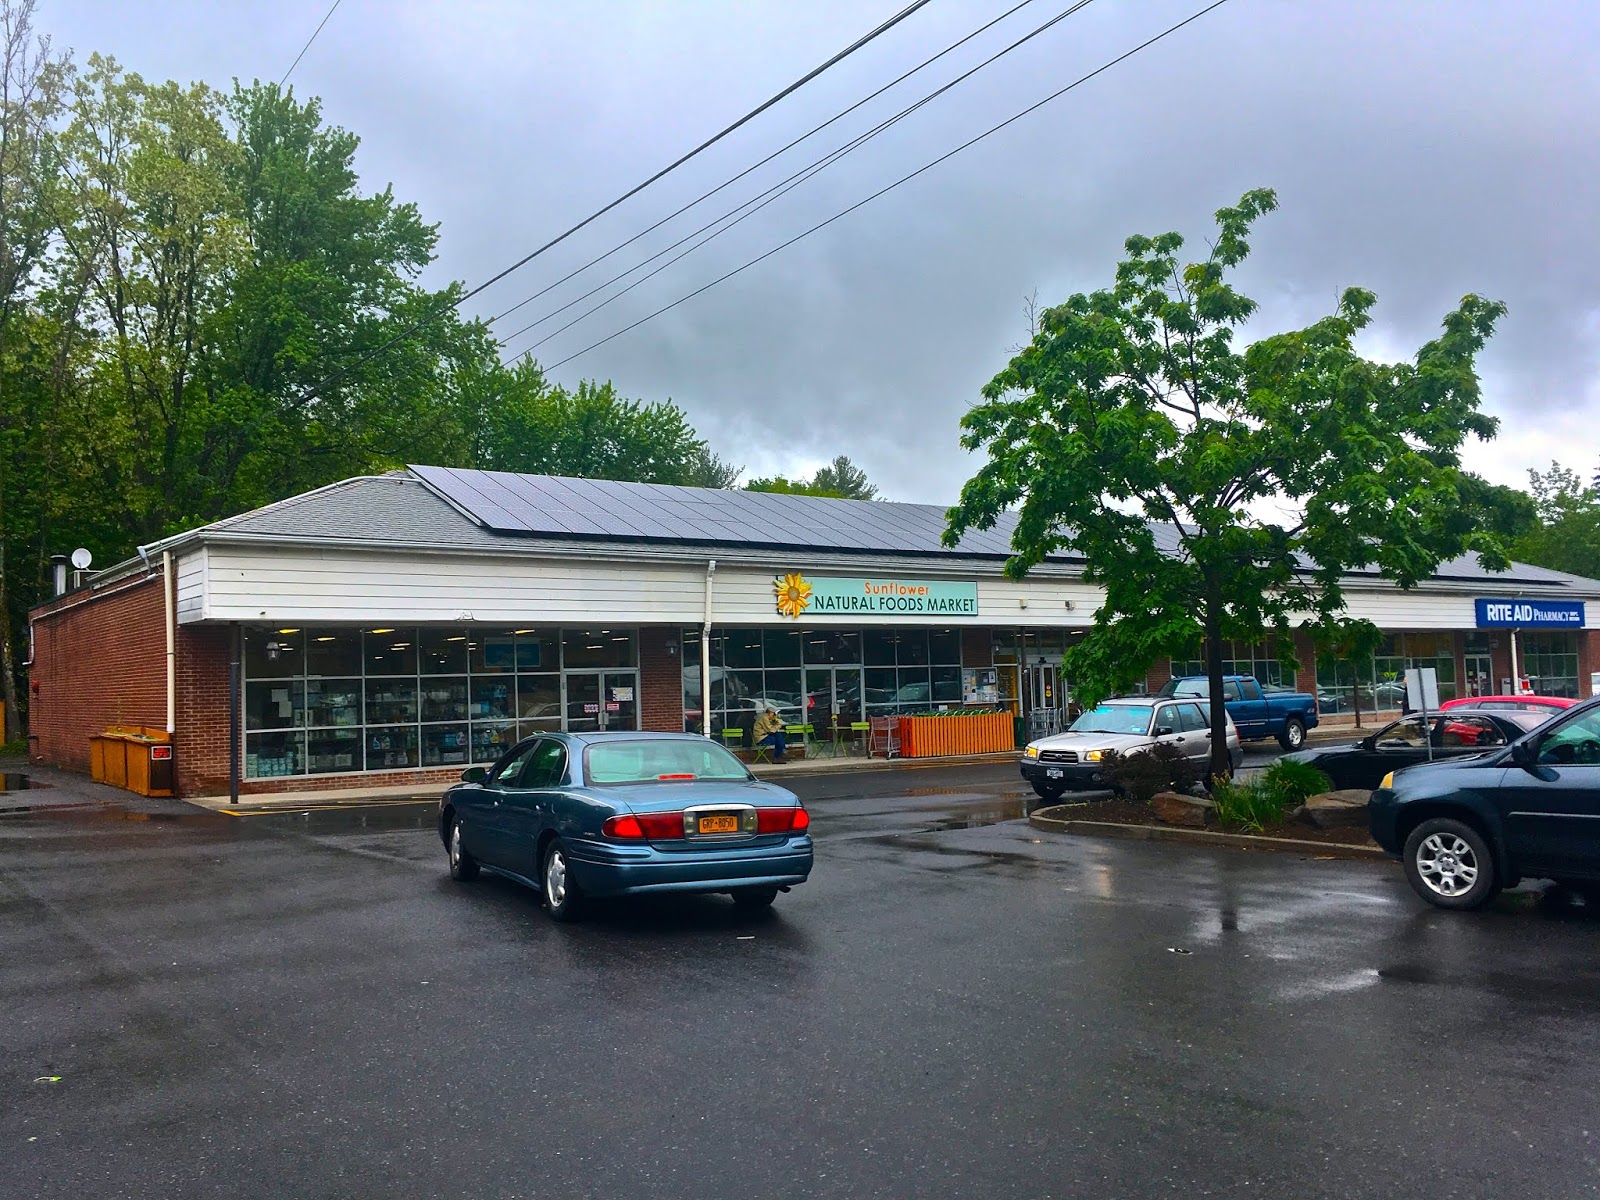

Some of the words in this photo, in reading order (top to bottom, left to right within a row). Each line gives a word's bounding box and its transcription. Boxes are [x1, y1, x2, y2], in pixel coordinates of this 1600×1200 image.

[864, 582, 930, 595] Sunflower
[814, 595, 876, 610] NATURAL
[879, 597, 924, 611] FOODS
[927, 598, 975, 612] MARKET
[1487, 604, 1512, 621] RITE
[1514, 605, 1533, 622] AID
[1533, 609, 1569, 621] PHARMACY
